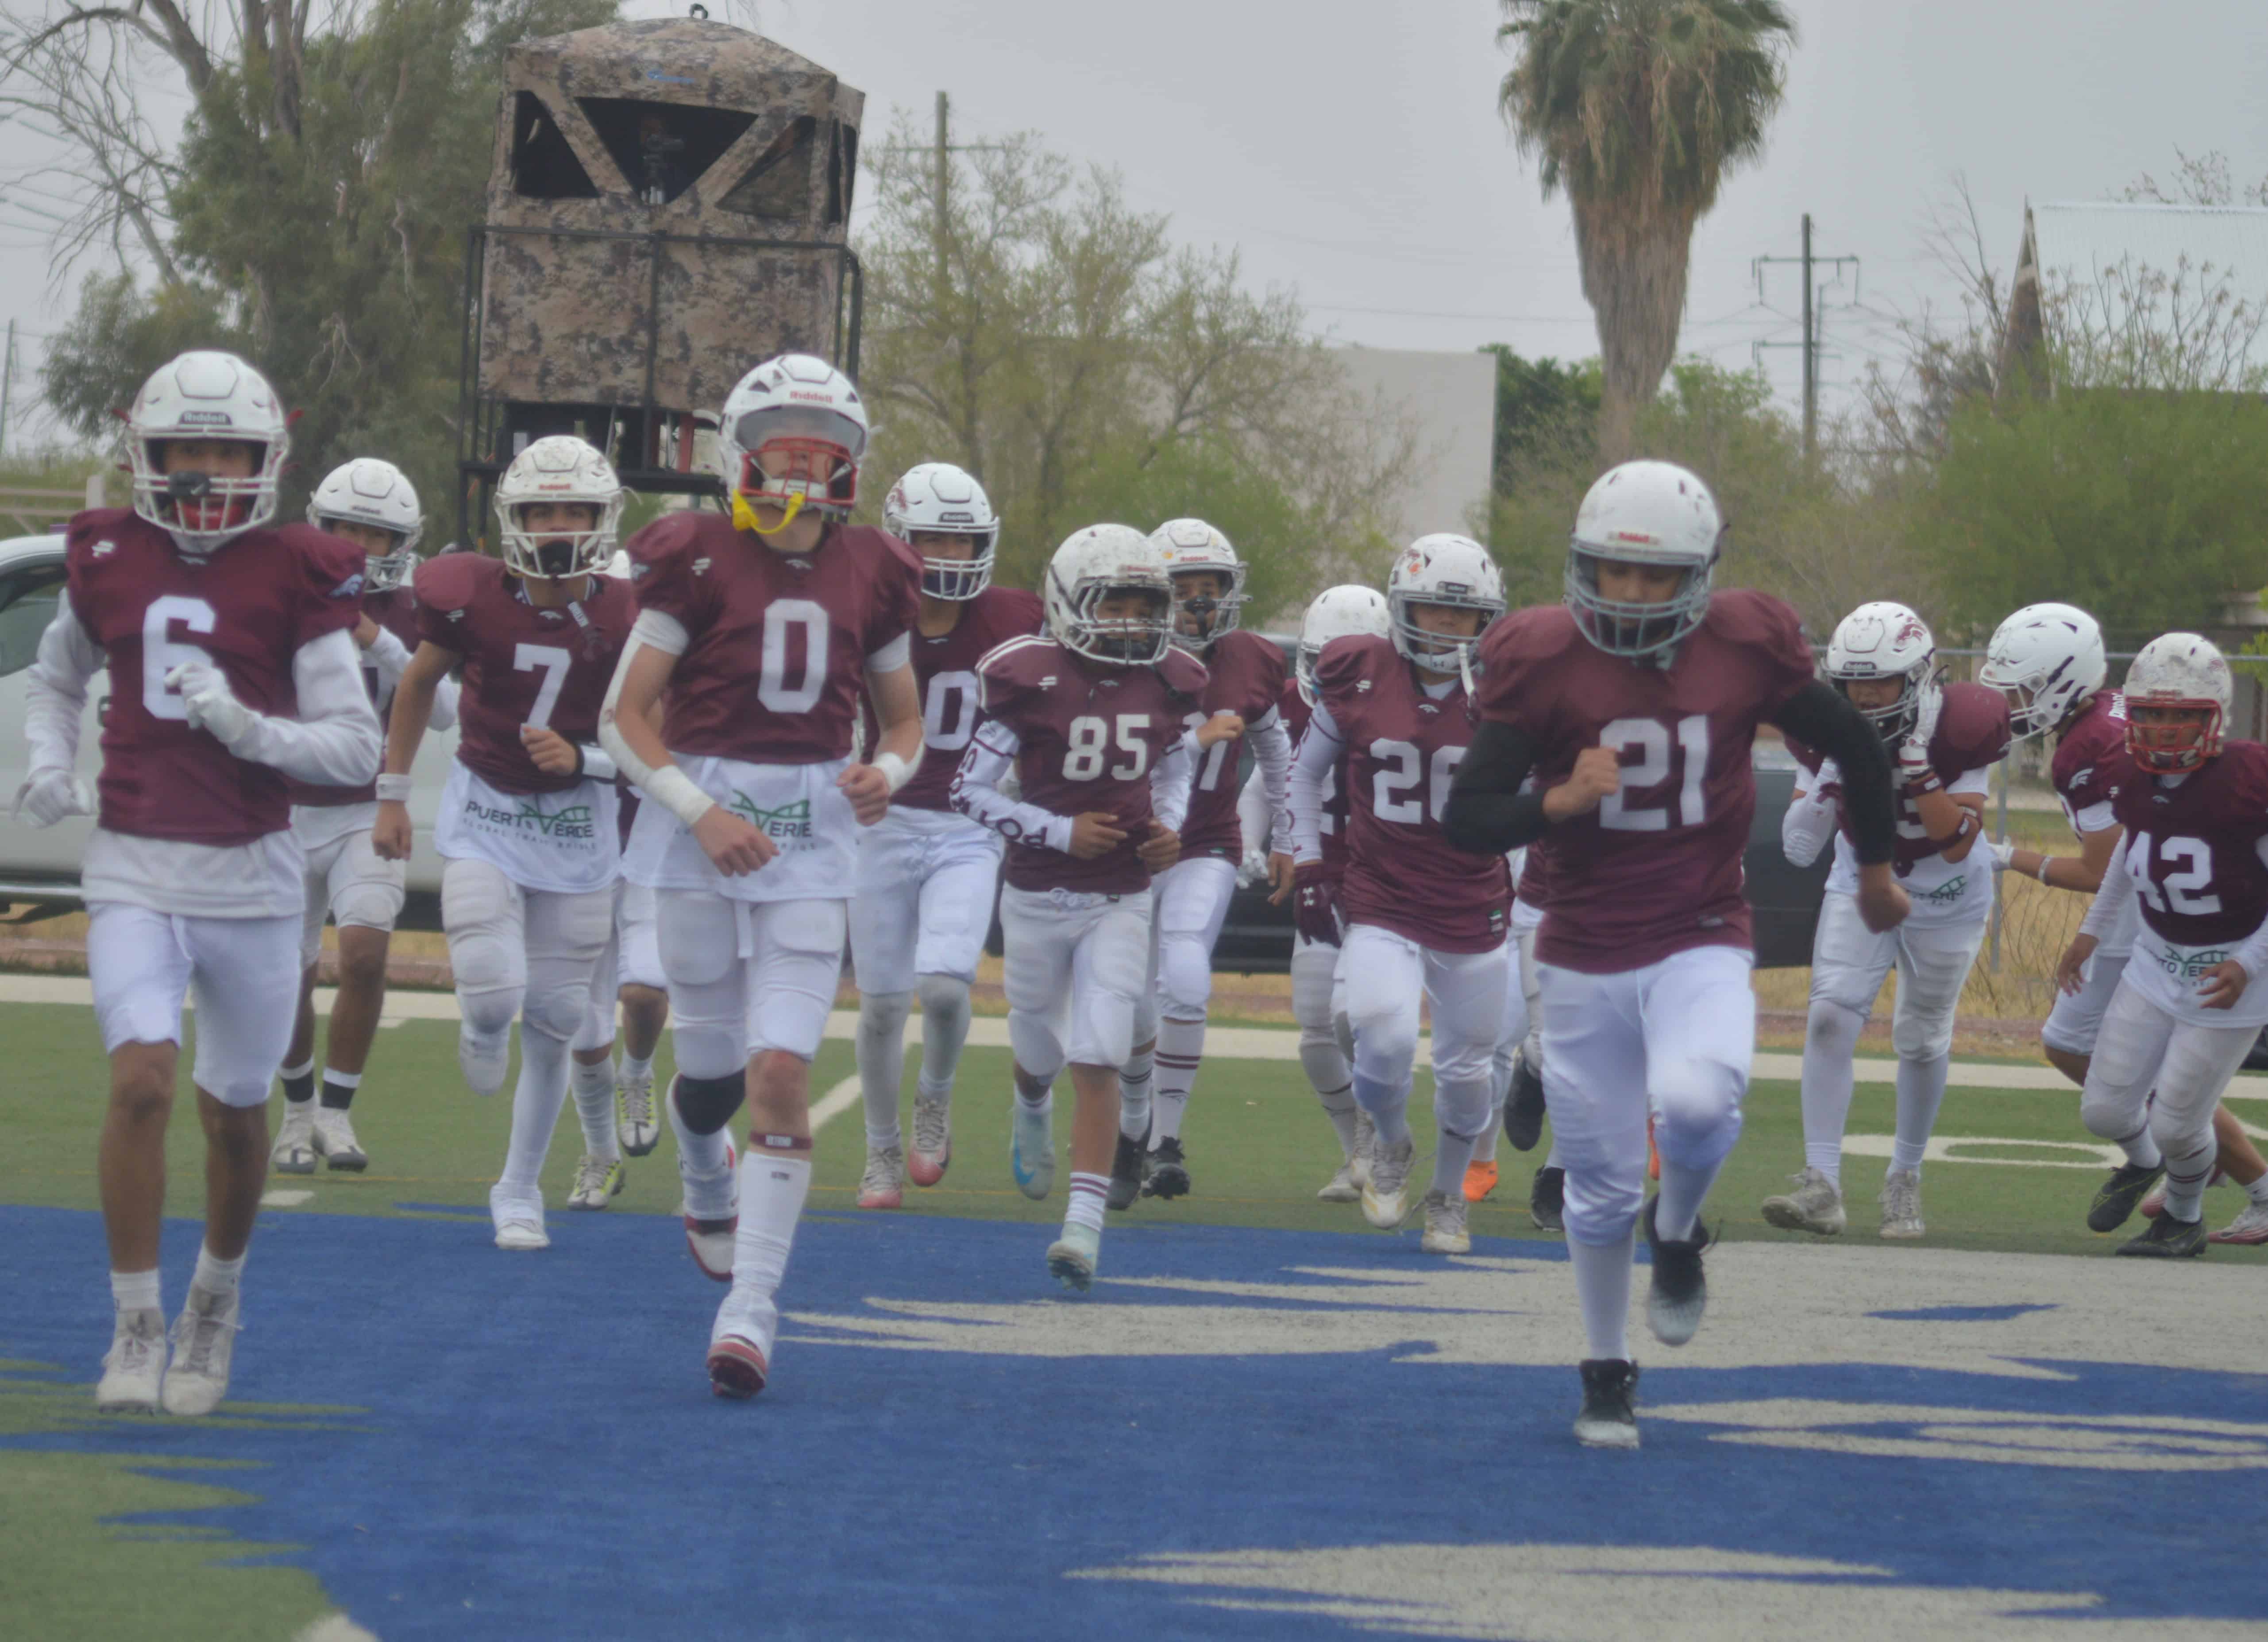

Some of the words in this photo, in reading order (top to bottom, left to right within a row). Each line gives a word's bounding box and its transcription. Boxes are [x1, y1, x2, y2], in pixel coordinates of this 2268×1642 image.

[143, 595, 216, 720] 6
[513, 643, 572, 737] 7
[757, 599, 829, 713] 0
[924, 671, 978, 748] 0
[1062, 714, 1149, 781] 85
[1600, 715, 1708, 832] 21
[2125, 831, 2222, 915] 42
